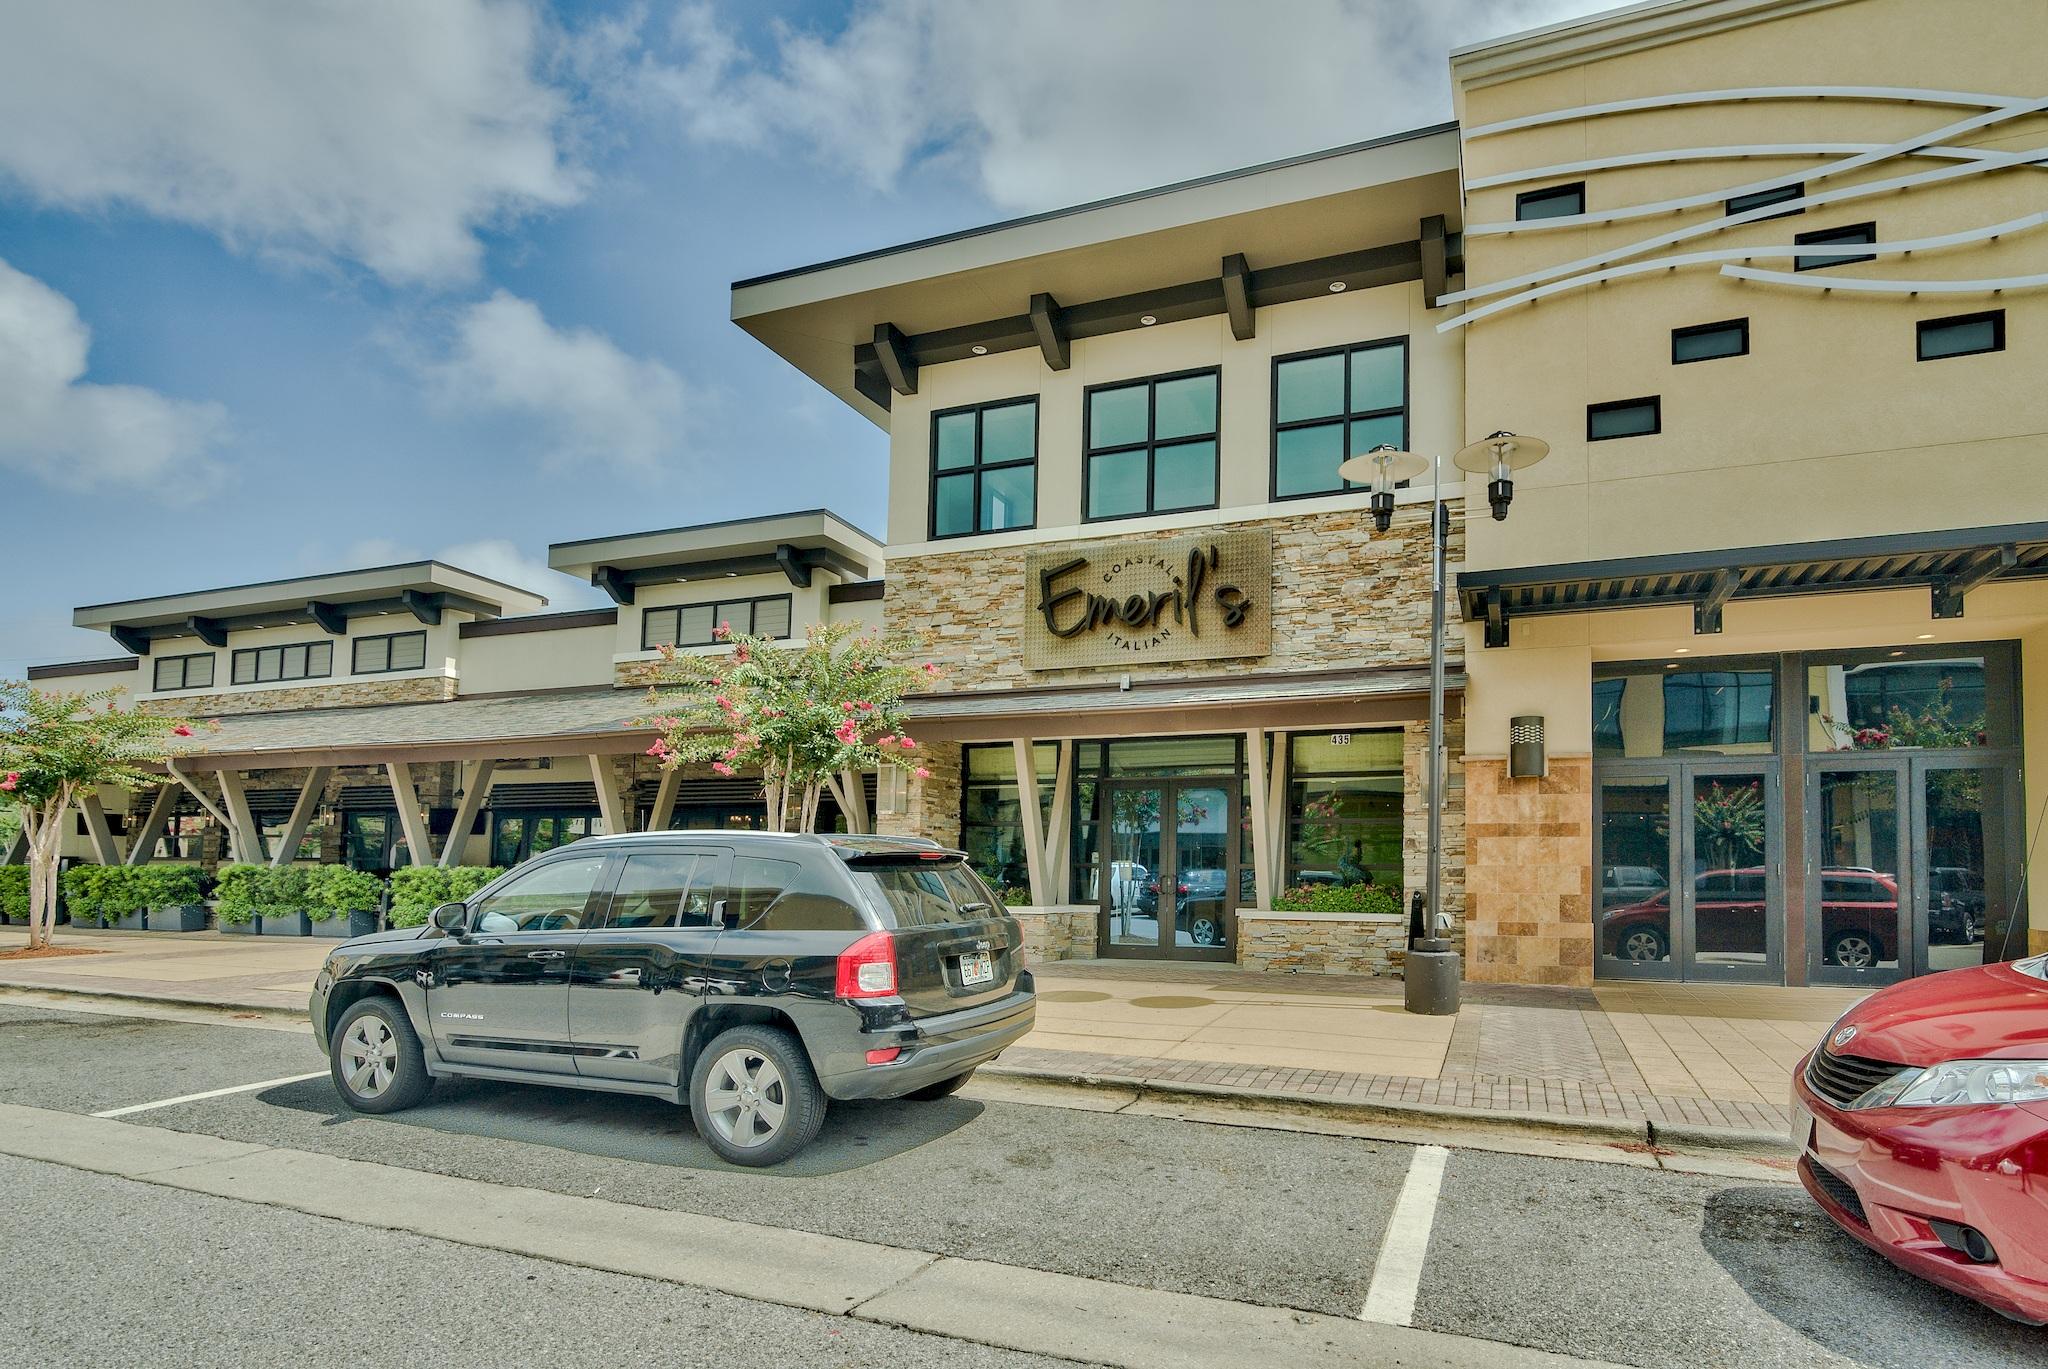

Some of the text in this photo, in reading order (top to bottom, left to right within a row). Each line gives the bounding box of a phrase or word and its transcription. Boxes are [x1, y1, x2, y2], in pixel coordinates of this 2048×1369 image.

[1103, 555, 1173, 584] COASTAL
[1037, 544, 1252, 639] Emeril's
[1107, 627, 1171, 651] ITALIAN
[1332, 734, 1349, 744] 435
[440, 1012, 484, 1020] COMPASS
